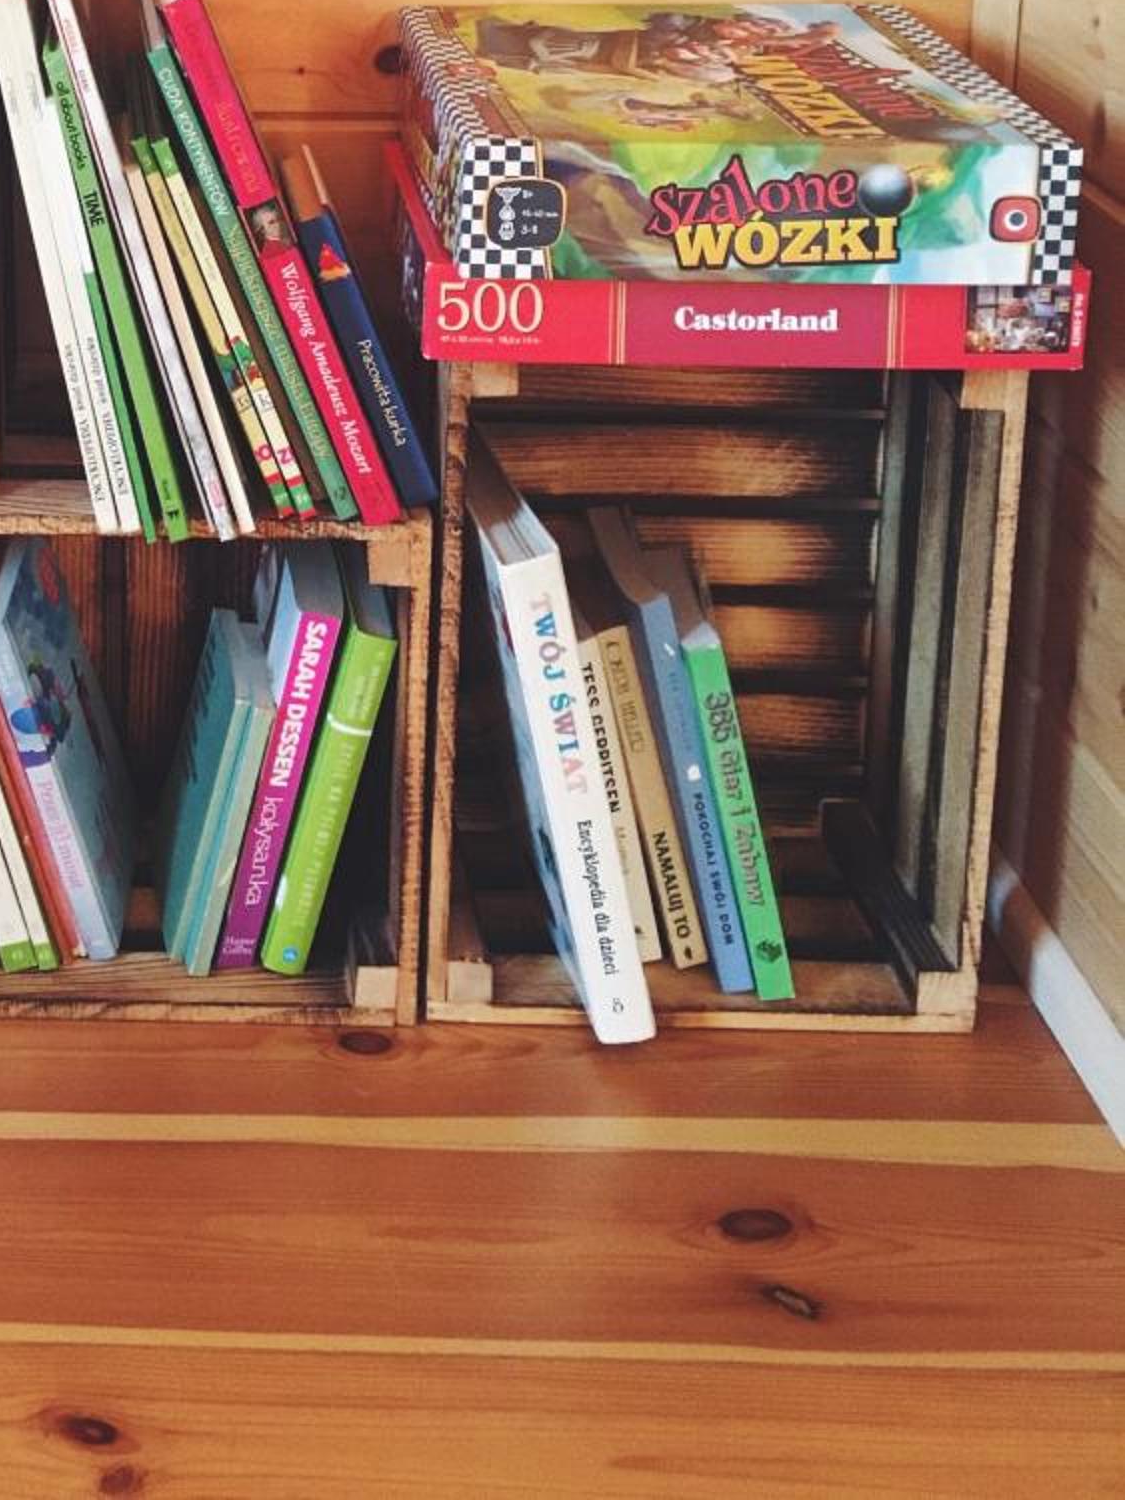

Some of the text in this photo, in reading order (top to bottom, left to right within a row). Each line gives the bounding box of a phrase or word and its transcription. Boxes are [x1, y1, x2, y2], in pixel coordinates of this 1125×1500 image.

[57, 96, 79, 132] about
[66, 132, 89, 170] books
[160, 67, 182, 109] CUDA
[175, 108, 233, 217] KONTYNENTÓW
[81, 190, 106, 228] TIME
[647, 154, 858, 236] Szalone
[674, 210, 900, 269] WÓZKI
[437, 282, 544, 334] 500
[674, 306, 838, 332] Castorland
[279, 262, 372, 473] Wolfgang Amadeusz Mozart
[357, 339, 408, 447] Pracowita kurka
[270, 622, 327, 787] SARAH DESSEN
[529, 593, 586, 796] TWÓJ ŚWIAT
[580, 662, 599, 708] TESS
[705, 690, 738, 743] 365
[245, 795, 283, 905] kołysanka
[654, 833, 691, 939] NAMALUJ TO
[693, 792, 735, 945] POKOCHAJ SWÓJ DOM
[577, 819, 617, 976] Encyklopedia dla dzieci
